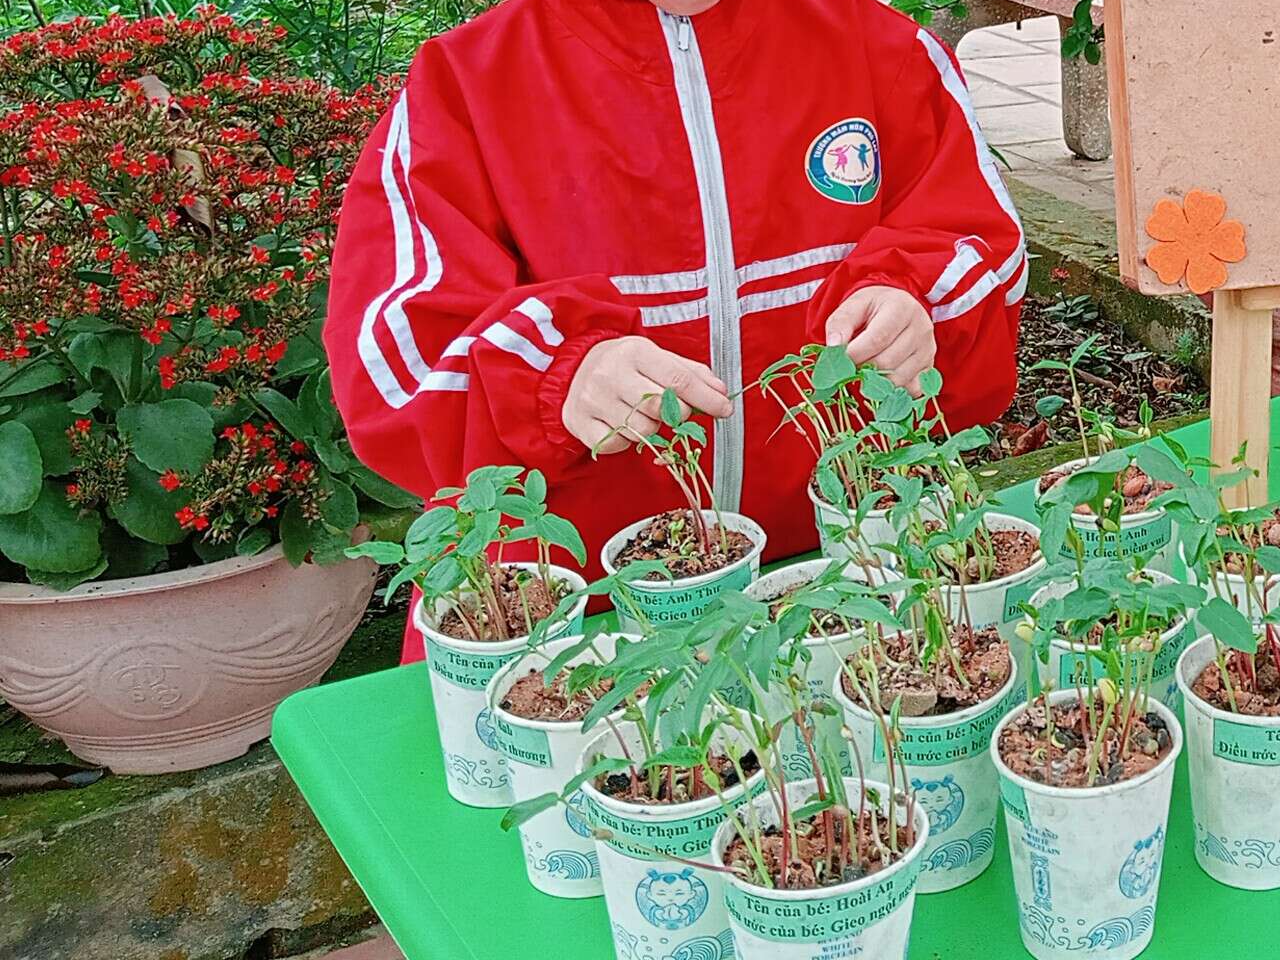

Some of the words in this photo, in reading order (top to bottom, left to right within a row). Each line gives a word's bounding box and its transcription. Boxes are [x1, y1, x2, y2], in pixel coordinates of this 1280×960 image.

[644, 593, 663, 606] bé:
[666, 593, 692, 605] Anh
[447, 651, 473, 666] Tên
[945, 728, 966, 742] bé:
[915, 748, 943, 762] ước
[944, 745, 969, 760] của
[1218, 740, 1248, 758] Điều
[1251, 748, 1278, 761] ước
[621, 823, 642, 837] bé:
[645, 824, 690, 840] Phạm
[743, 895, 770, 916] Tên
[774, 902, 802, 918] của
[806, 902, 831, 917] bé:
[836, 890, 872, 912] Hoài
[874, 880, 894, 898] An
[769, 925, 797, 938] của
[800, 923, 826, 938] bé:
[830, 914, 867, 934] Gieo
